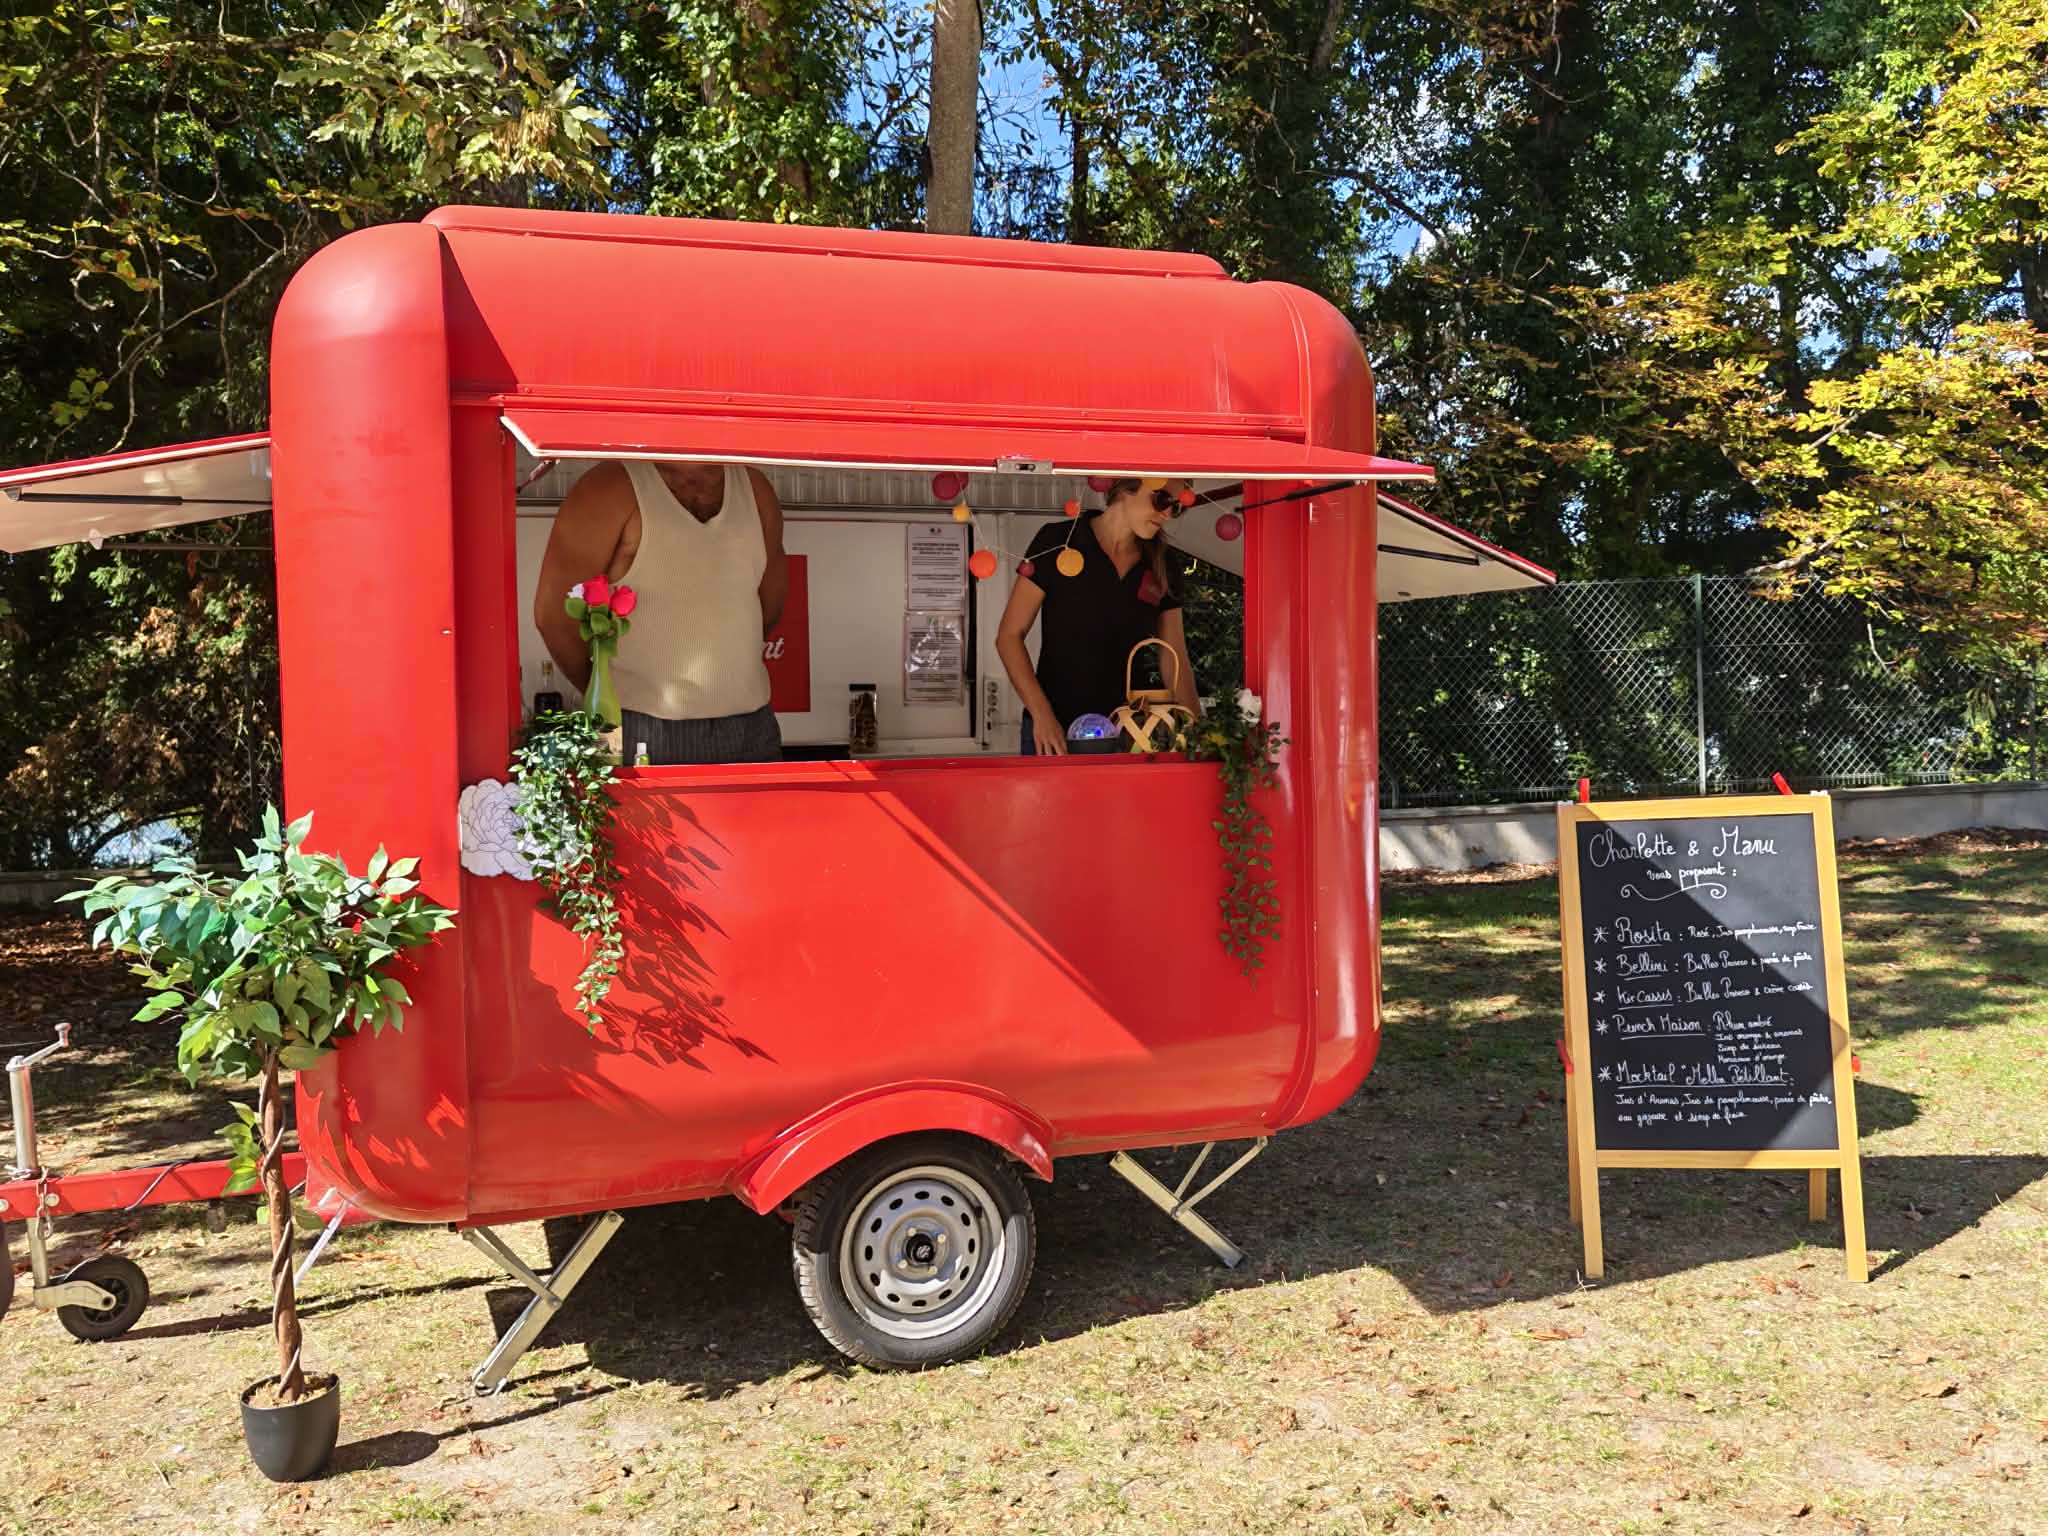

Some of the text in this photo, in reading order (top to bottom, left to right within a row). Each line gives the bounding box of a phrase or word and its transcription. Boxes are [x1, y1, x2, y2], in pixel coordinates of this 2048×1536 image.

[1589, 825, 1779, 868] Charlotte & Manu
[1615, 917, 1672, 944] Rosita
[1616, 952, 1668, 977] Bellini
[1684, 952, 1719, 973] Bulles
[1684, 981, 1720, 1003] Bulles
[1612, 1013, 1656, 1034] Punch
[1660, 1013, 1703, 1033] Maison
[1616, 1059, 1677, 1084] Mocktail
